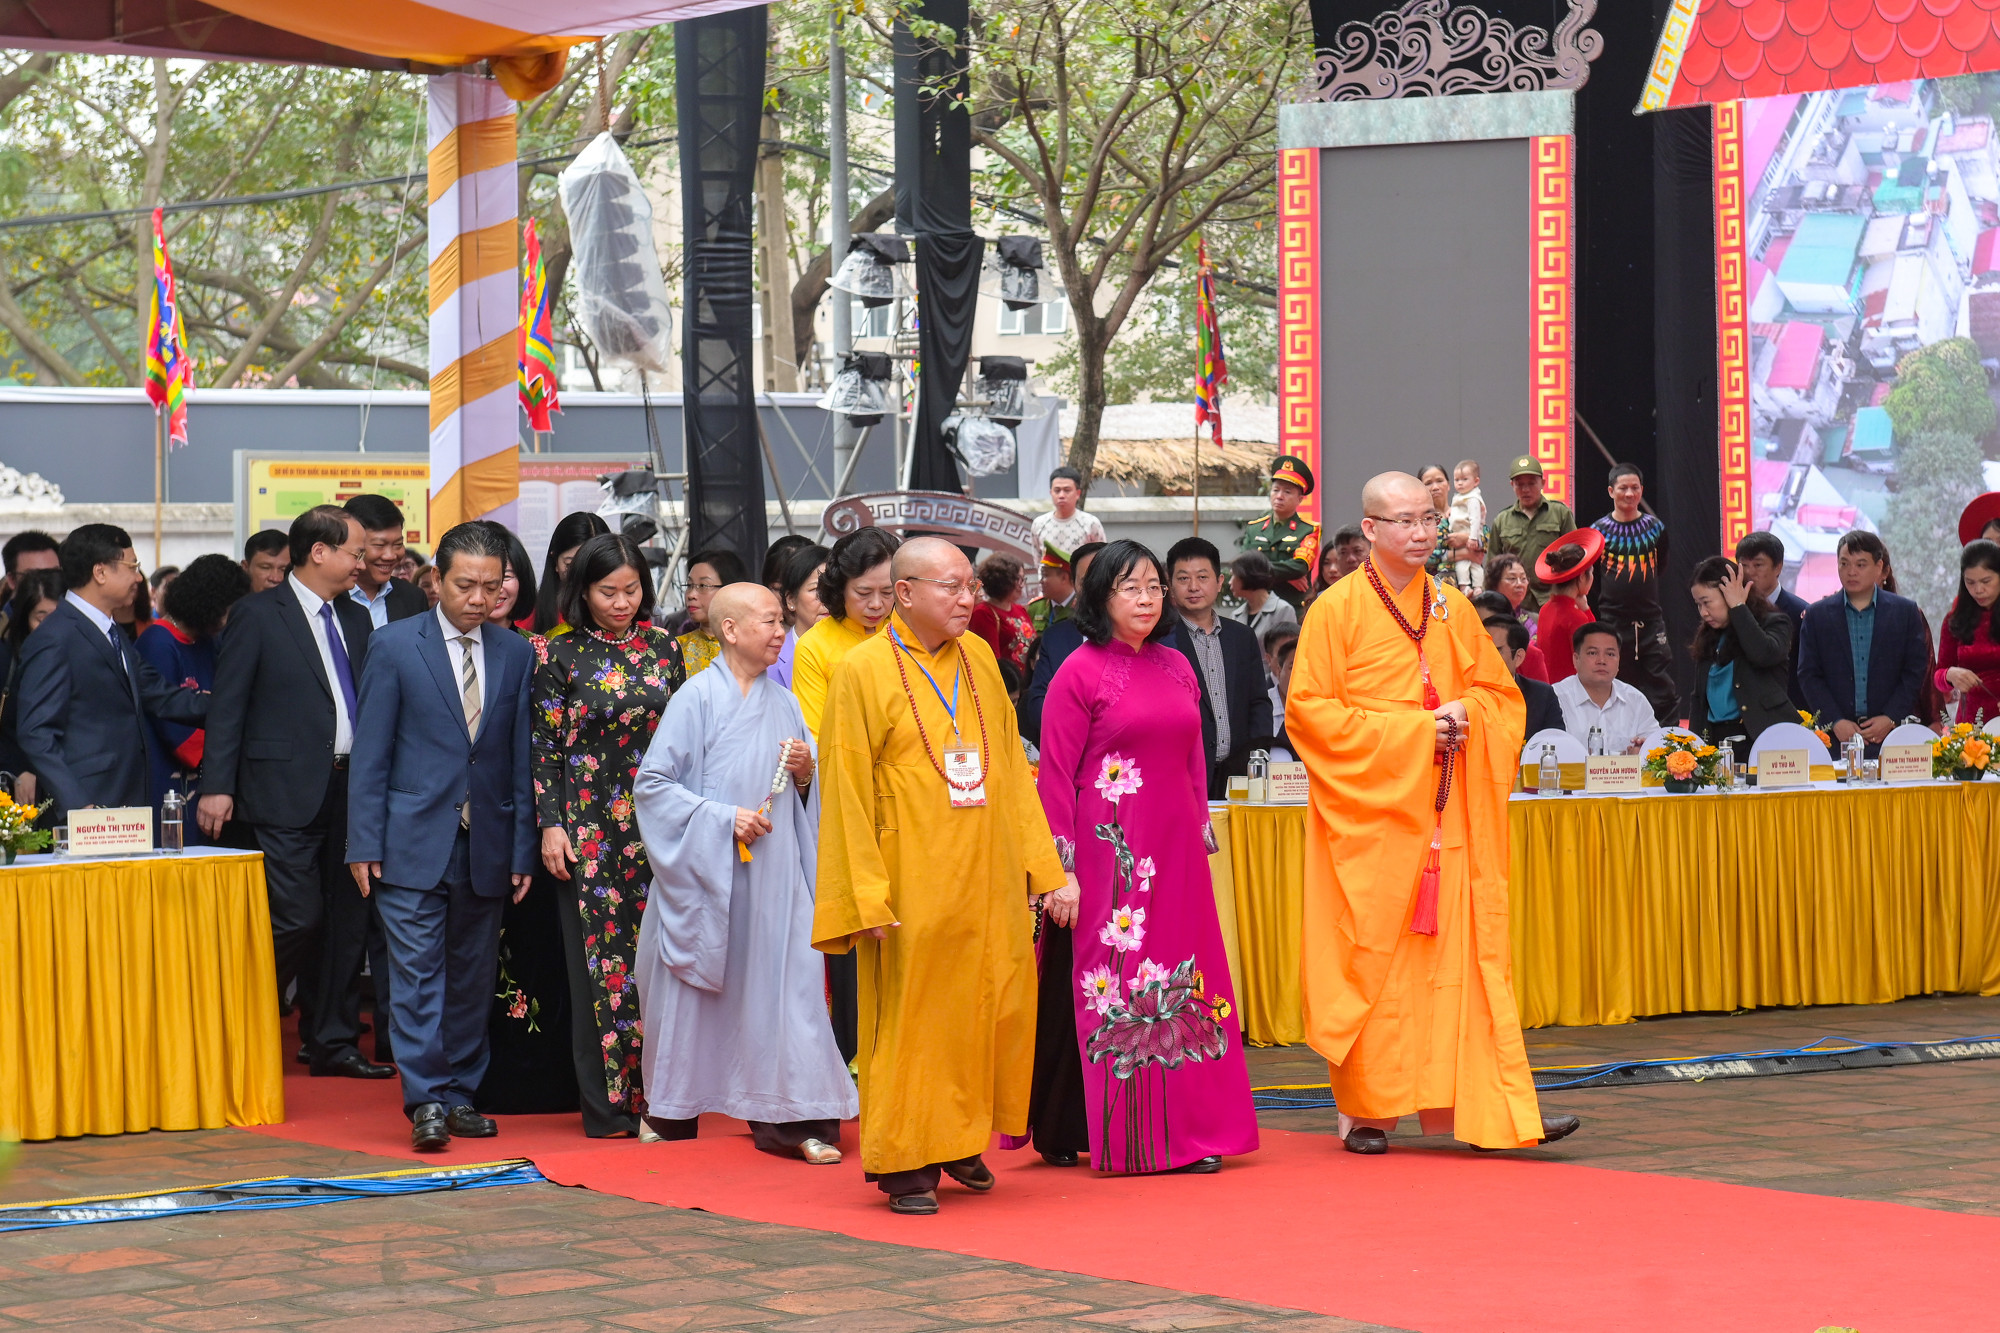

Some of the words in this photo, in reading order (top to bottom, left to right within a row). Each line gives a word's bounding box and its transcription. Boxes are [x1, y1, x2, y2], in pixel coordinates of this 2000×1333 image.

[76, 824, 106, 834] NGUYỄN
[108, 824, 120, 834] THỊ
[122, 822, 146, 832] TUYẾN
